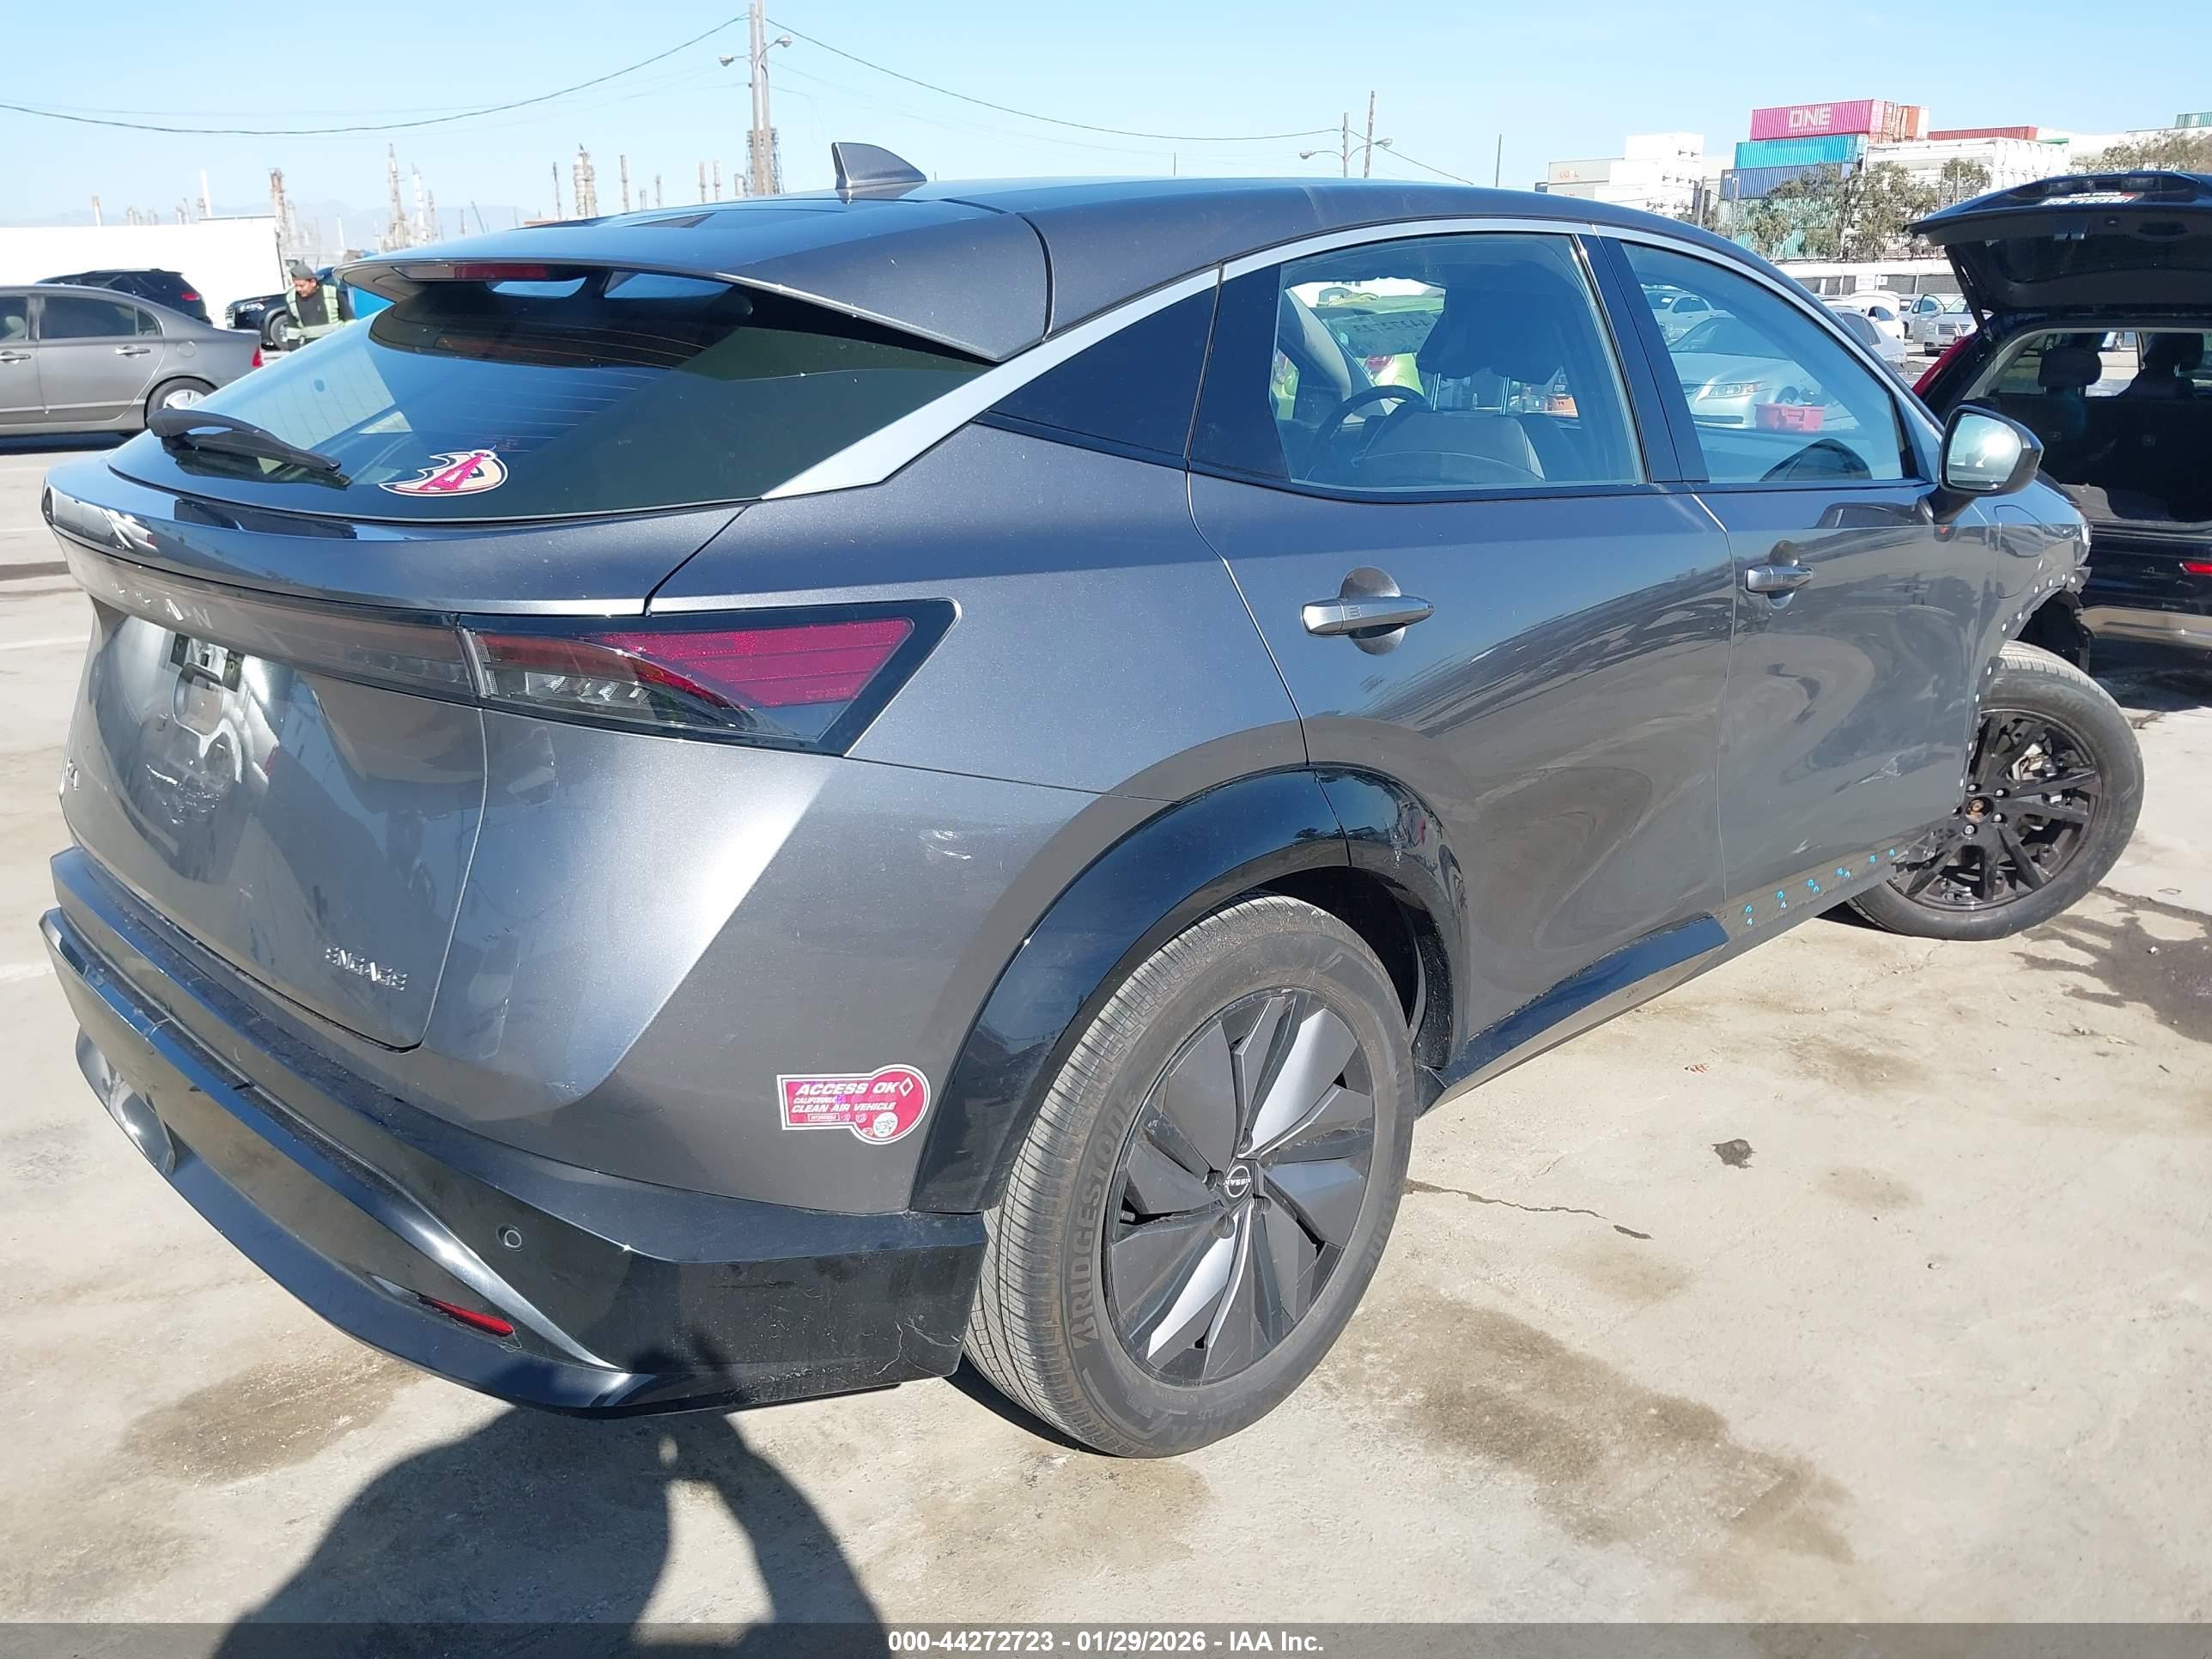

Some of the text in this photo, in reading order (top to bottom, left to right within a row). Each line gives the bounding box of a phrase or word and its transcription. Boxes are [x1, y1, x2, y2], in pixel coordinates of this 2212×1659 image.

[1789, 107, 1831, 128] ONE
[795, 1081, 901, 1096] ACCESS OK
[791, 1102, 897, 1114] CLEAN AIR VEHICLE
